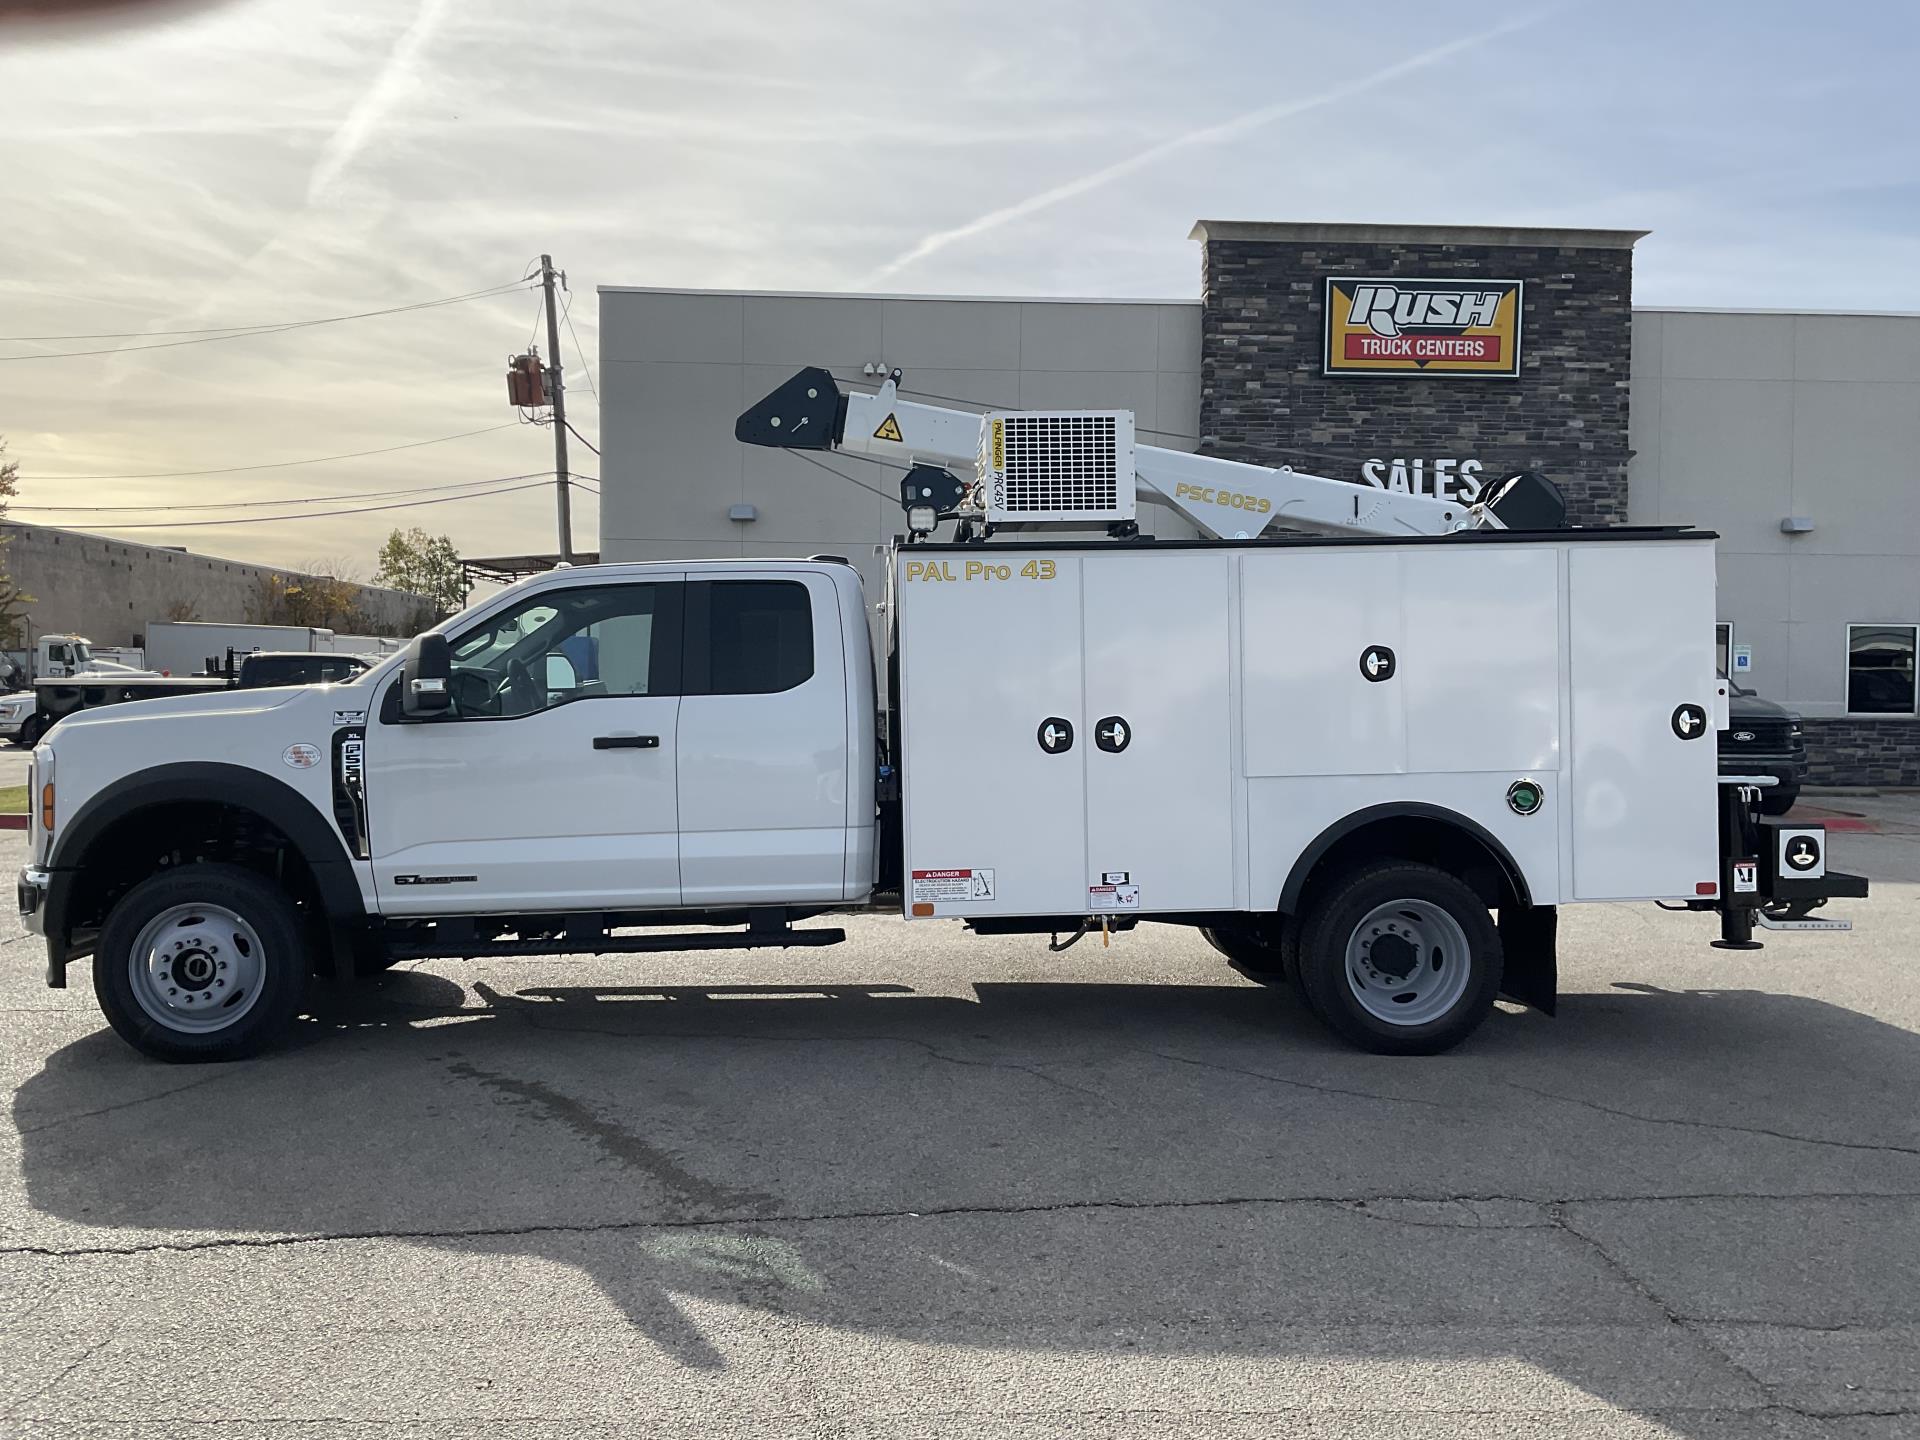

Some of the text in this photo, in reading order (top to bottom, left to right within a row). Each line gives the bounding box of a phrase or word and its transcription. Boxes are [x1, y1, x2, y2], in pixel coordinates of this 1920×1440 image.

[1347, 284, 1503, 338] RUSH
[1361, 339, 1485, 356] TRUCK CENTERS
[993, 421, 1002, 467] PALFINGER
[993, 471, 1004, 511] PRC45V
[1175, 482, 1271, 513] PSC 8029
[1361, 458, 1483, 502] SALES
[906, 559, 1057, 581] PAL Pro 43
